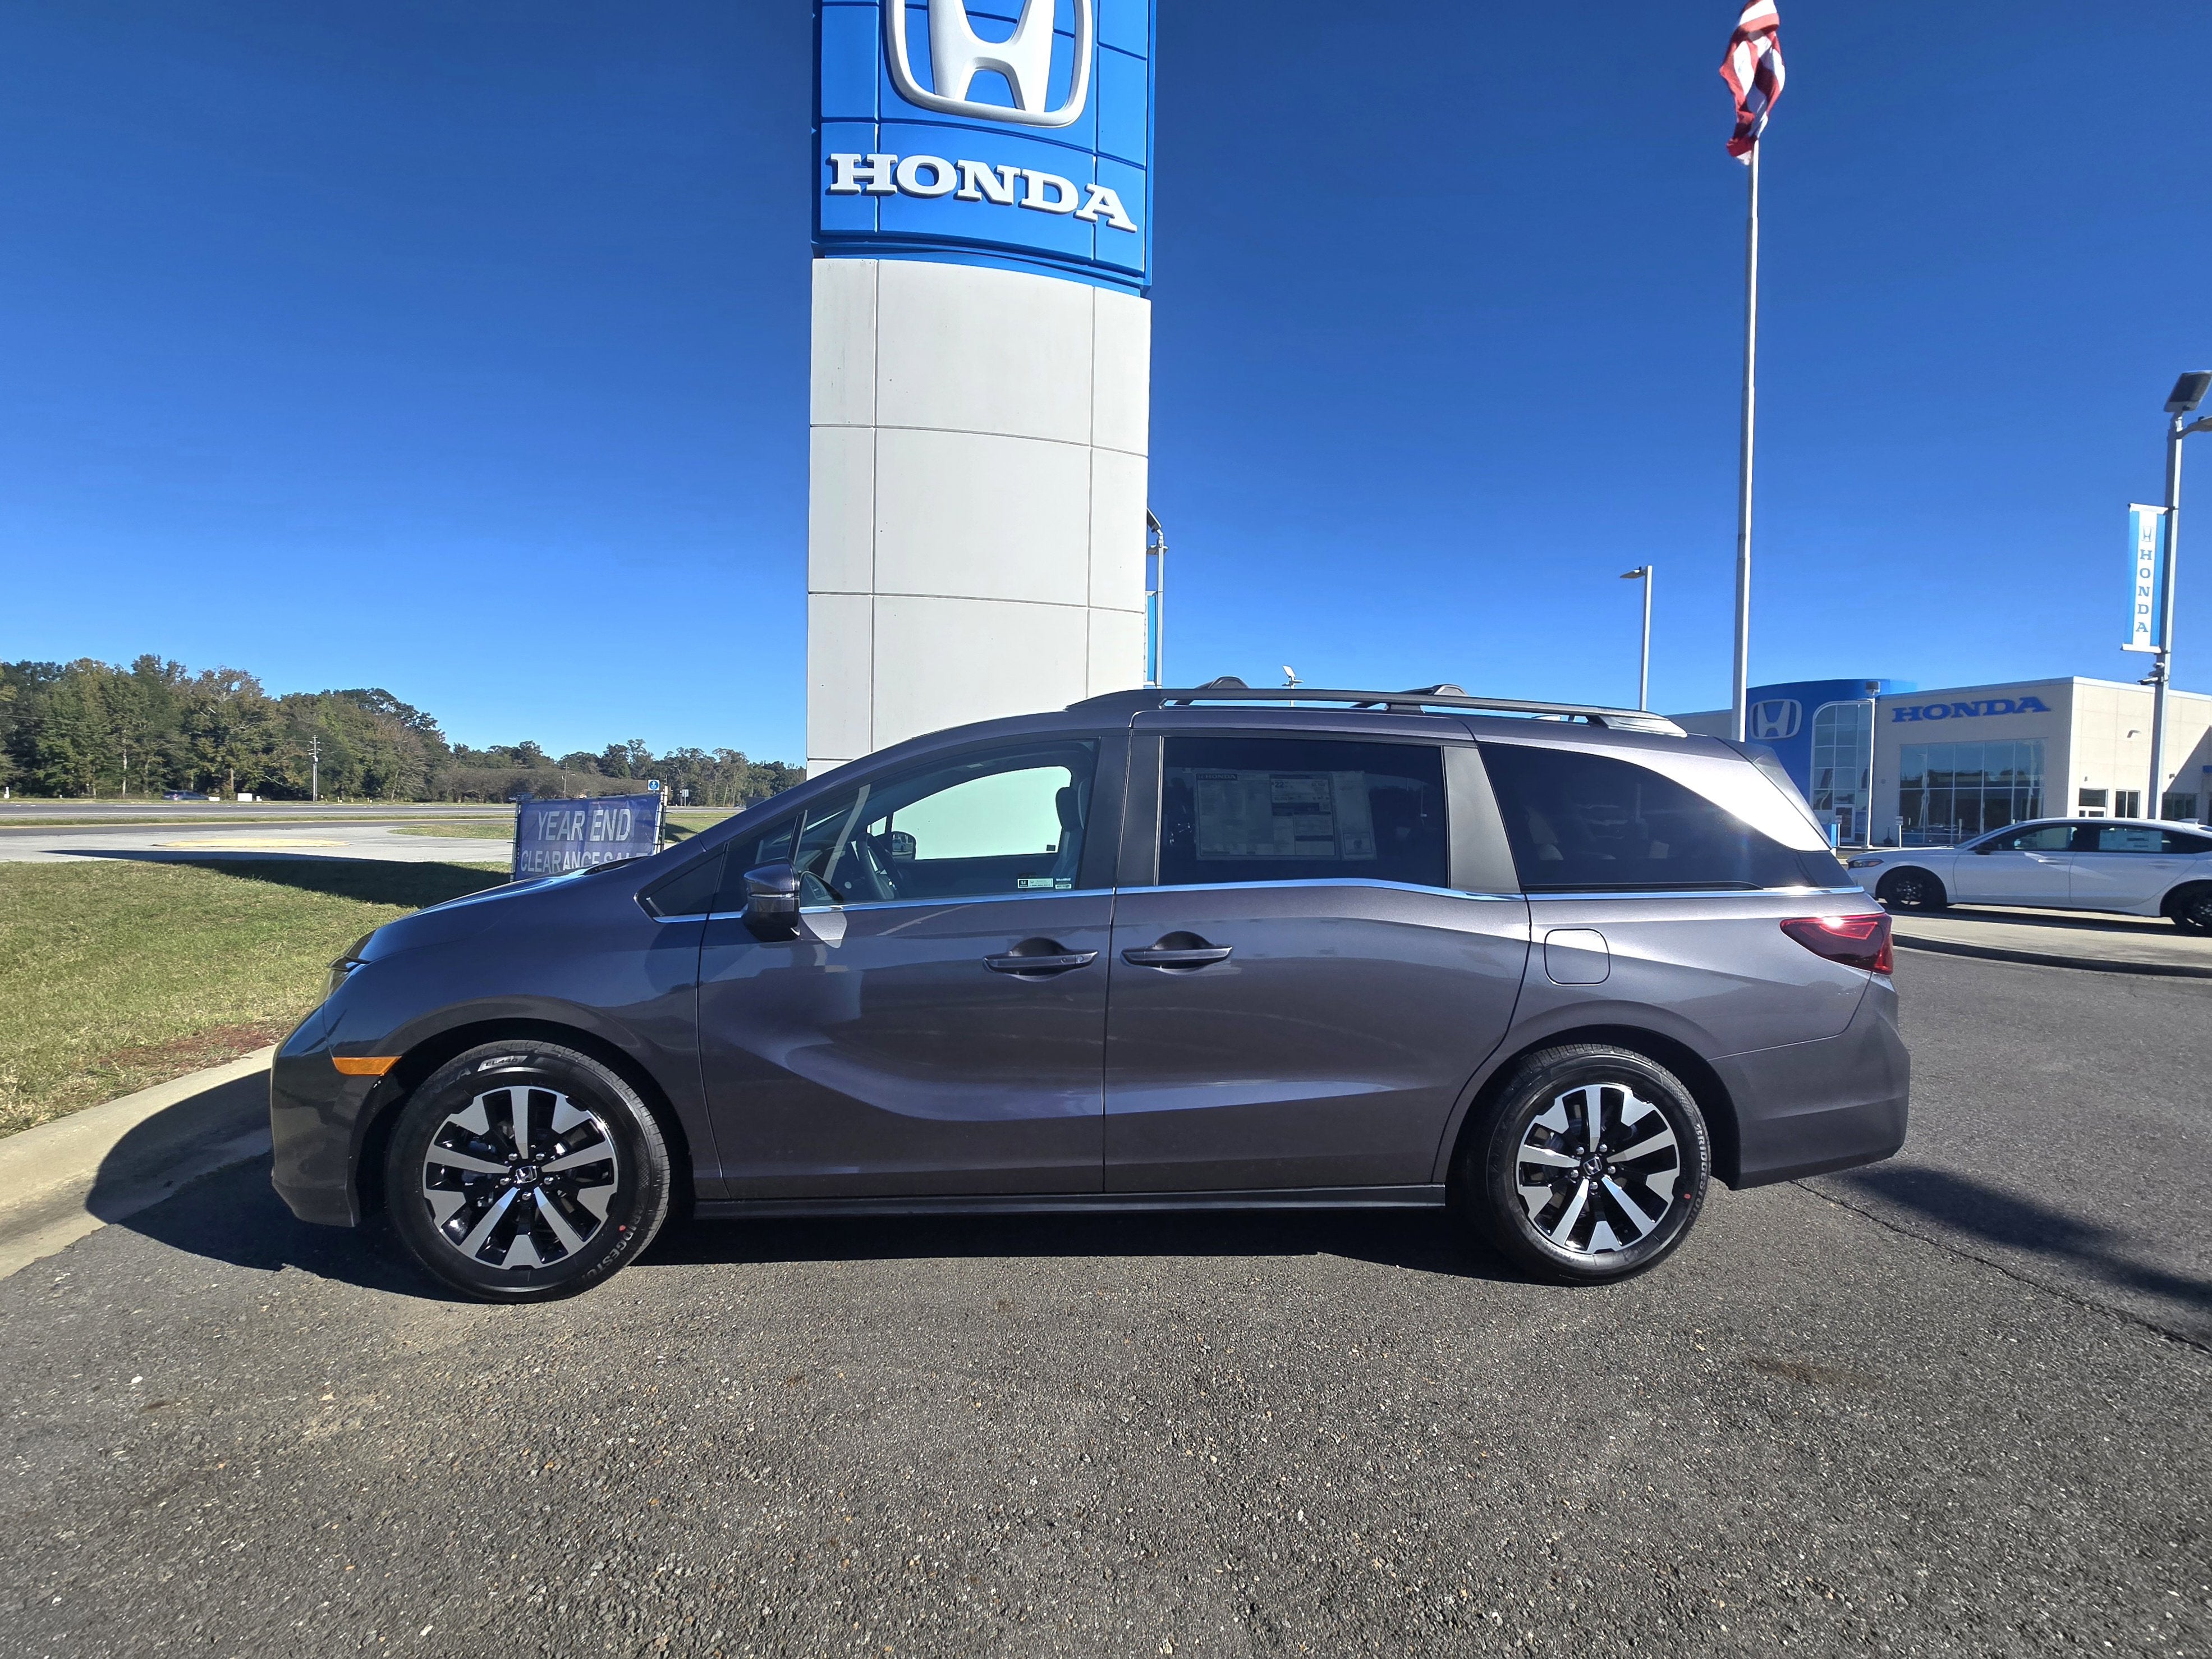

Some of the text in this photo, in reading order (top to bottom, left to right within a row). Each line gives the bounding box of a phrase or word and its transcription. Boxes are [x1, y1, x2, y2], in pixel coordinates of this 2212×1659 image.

[830, 153, 1137, 232] HONDA
[2136, 548, 2153, 632] HONDA
[1892, 696, 2050, 722] HONDA
[538, 809, 631, 841] YEAR END
[521, 850, 600, 873] CLEARANCE
